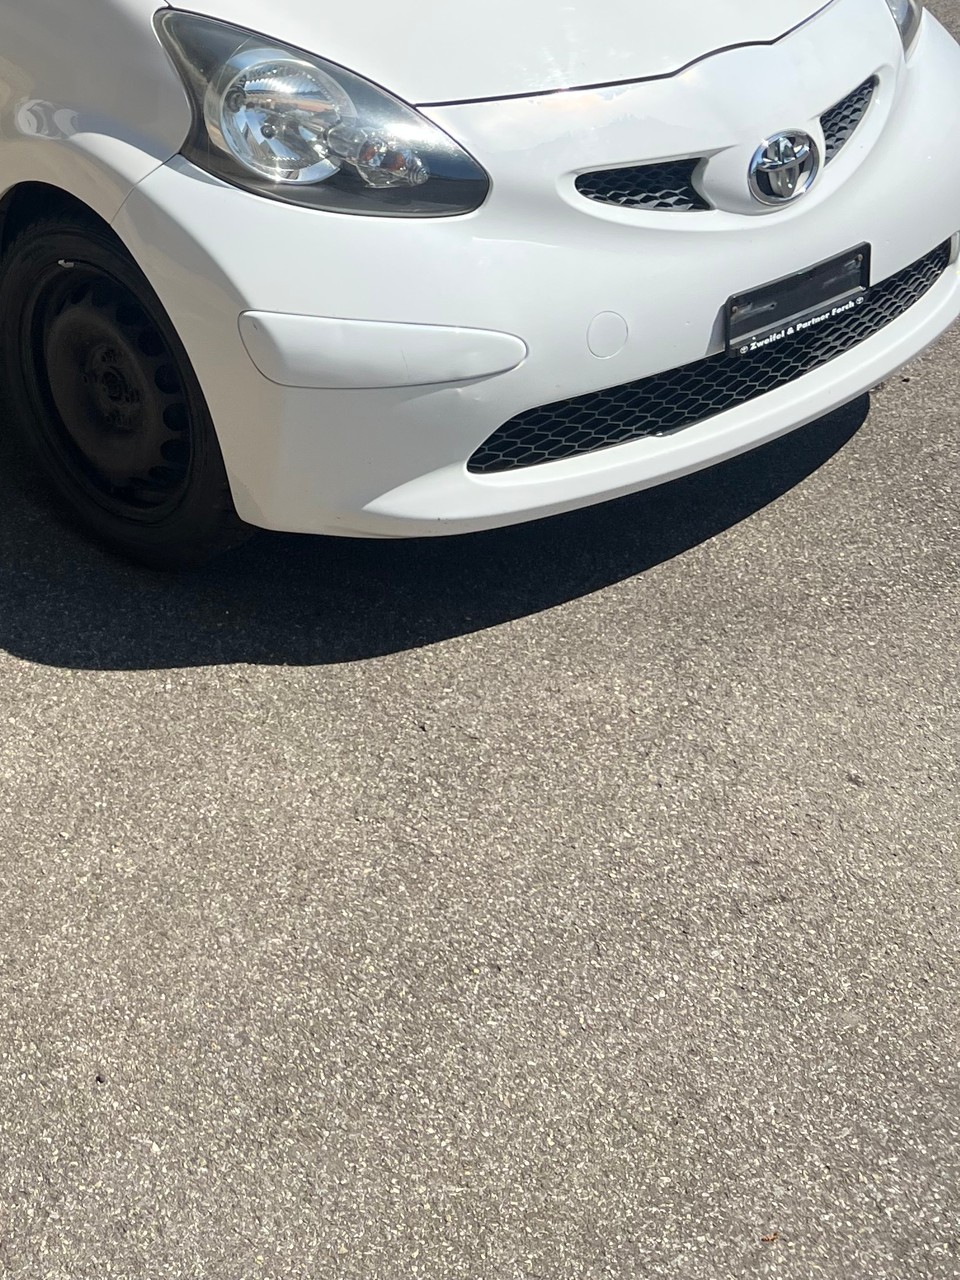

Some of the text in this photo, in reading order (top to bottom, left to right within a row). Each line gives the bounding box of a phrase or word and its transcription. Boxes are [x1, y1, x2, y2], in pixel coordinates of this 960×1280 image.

[749, 300, 855, 351] Zweifel & Partner Forch
